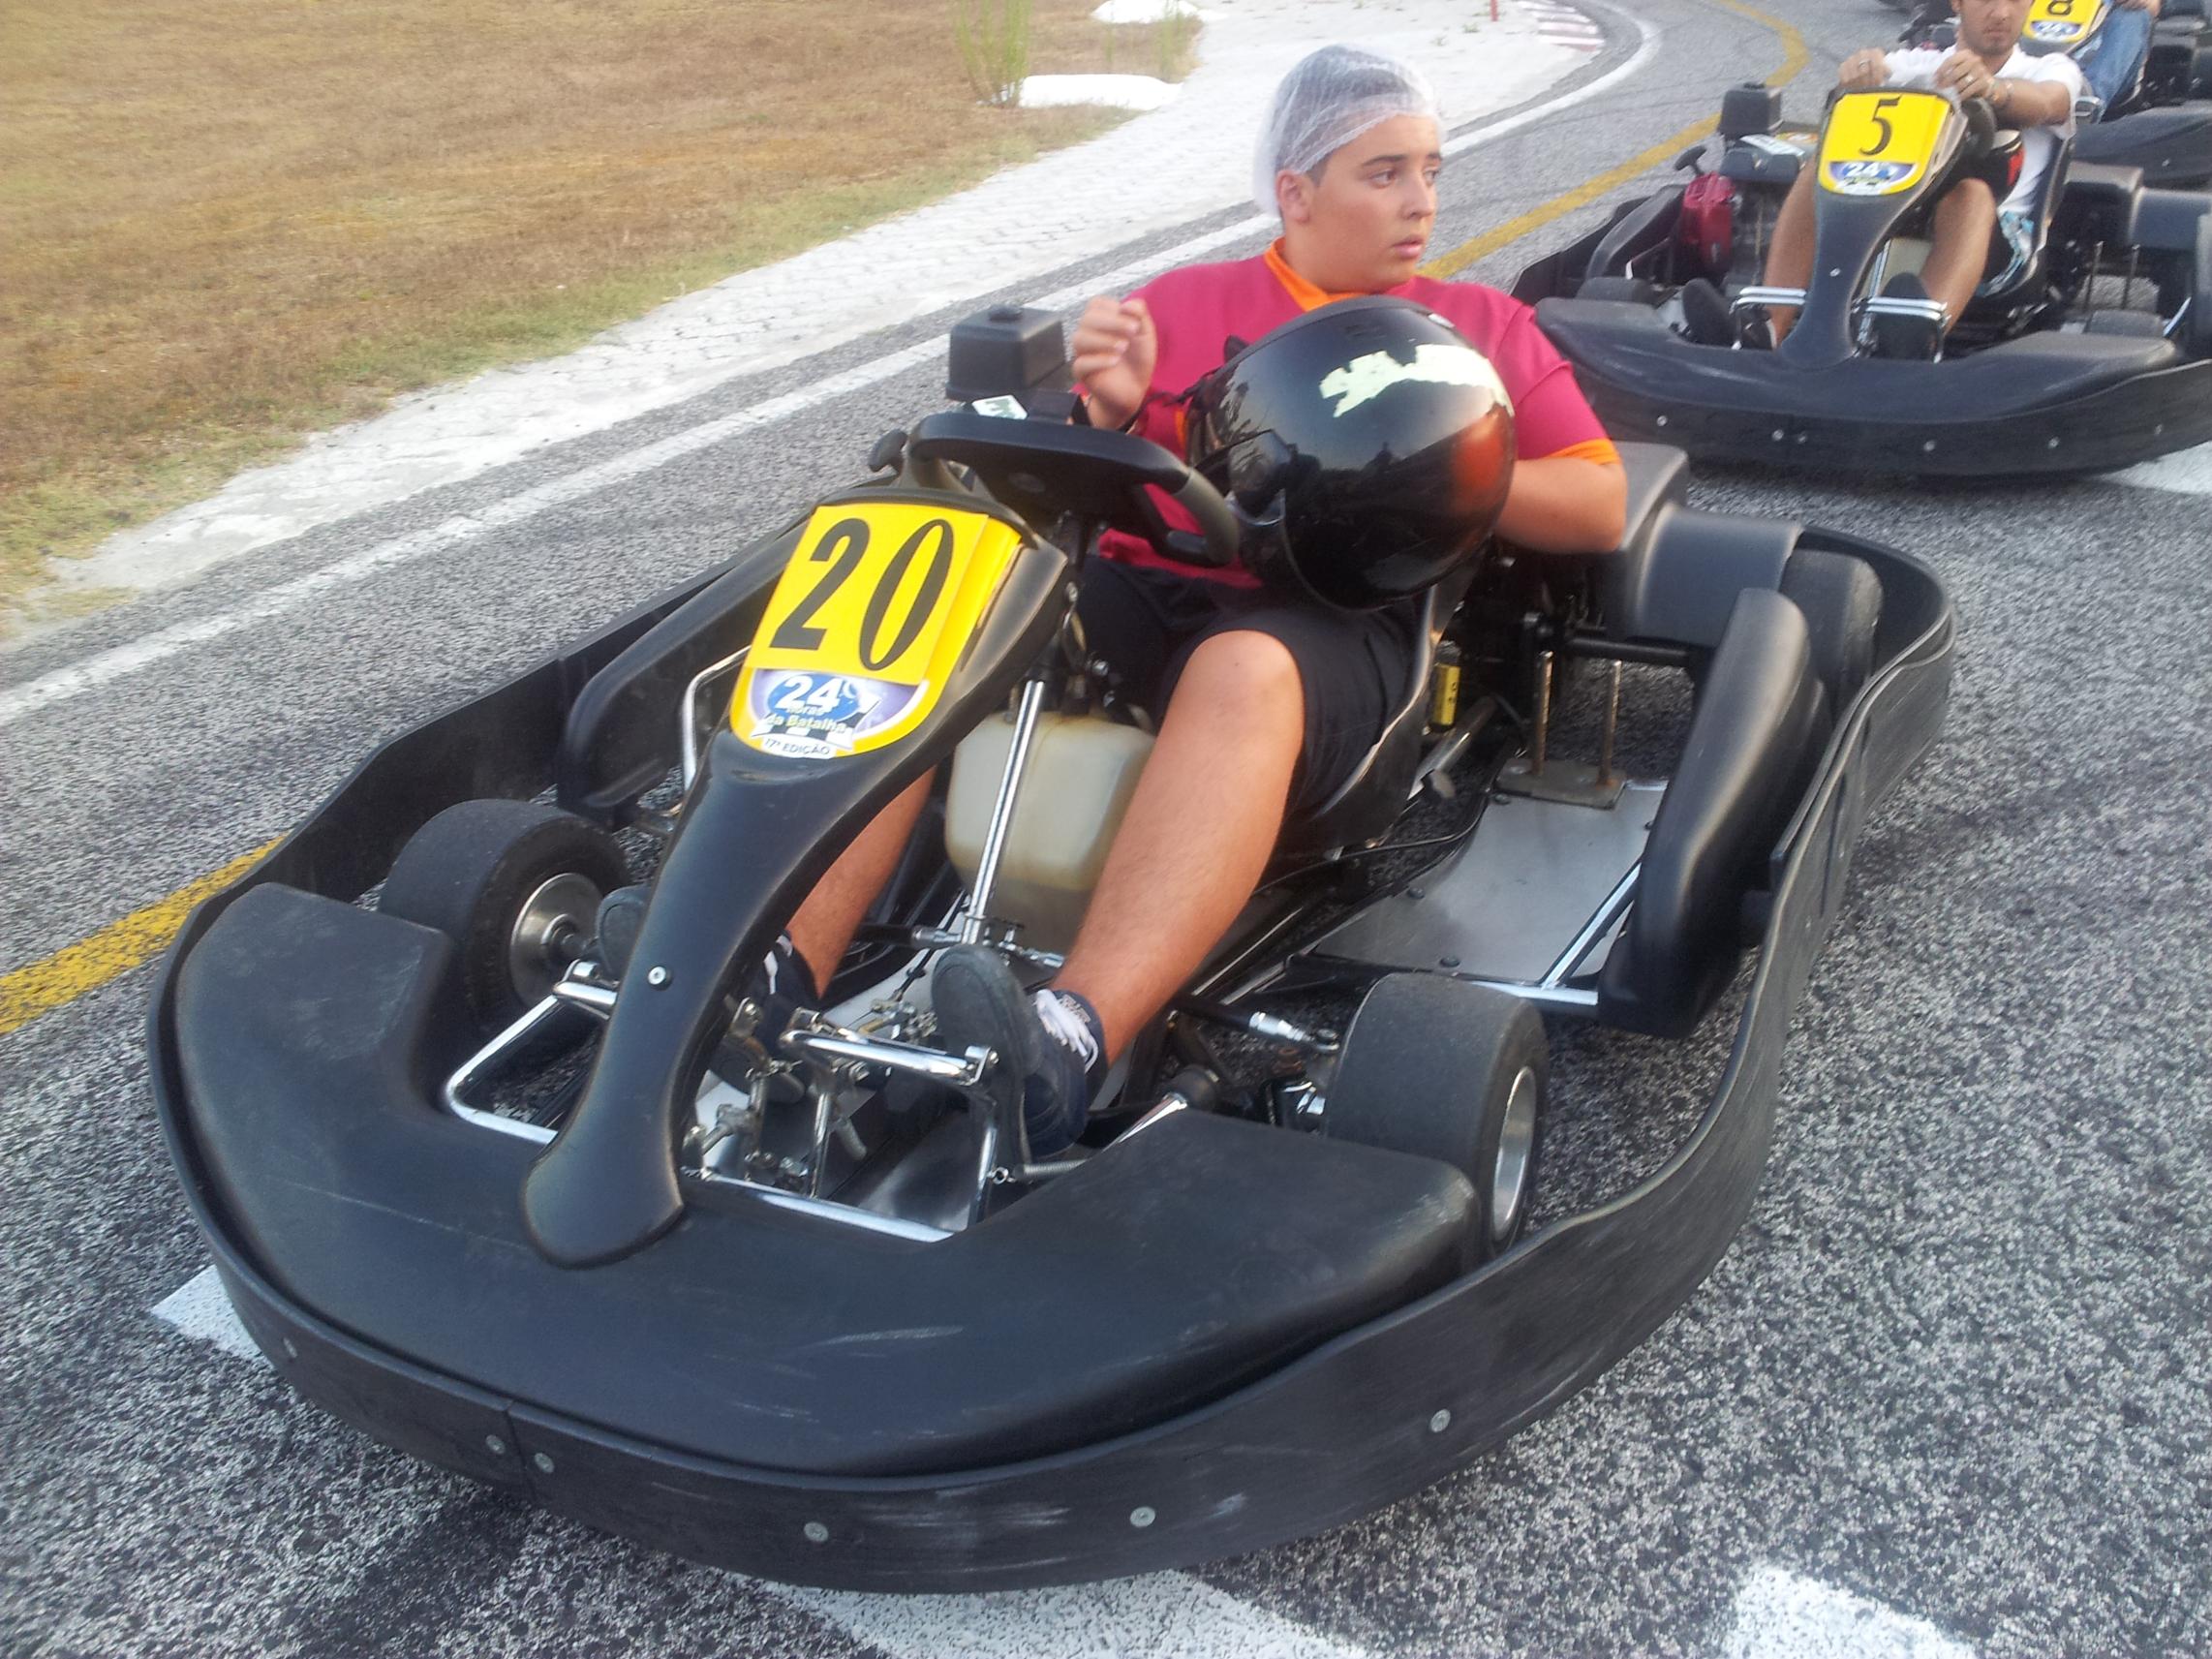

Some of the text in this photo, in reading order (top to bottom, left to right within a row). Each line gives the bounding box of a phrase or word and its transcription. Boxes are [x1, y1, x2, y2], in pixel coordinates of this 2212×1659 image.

[1859, 95, 1903, 156] 5
[769, 517, 955, 672] 20
[774, 675, 843, 712] 24
[785, 715, 848, 734] Batalha
